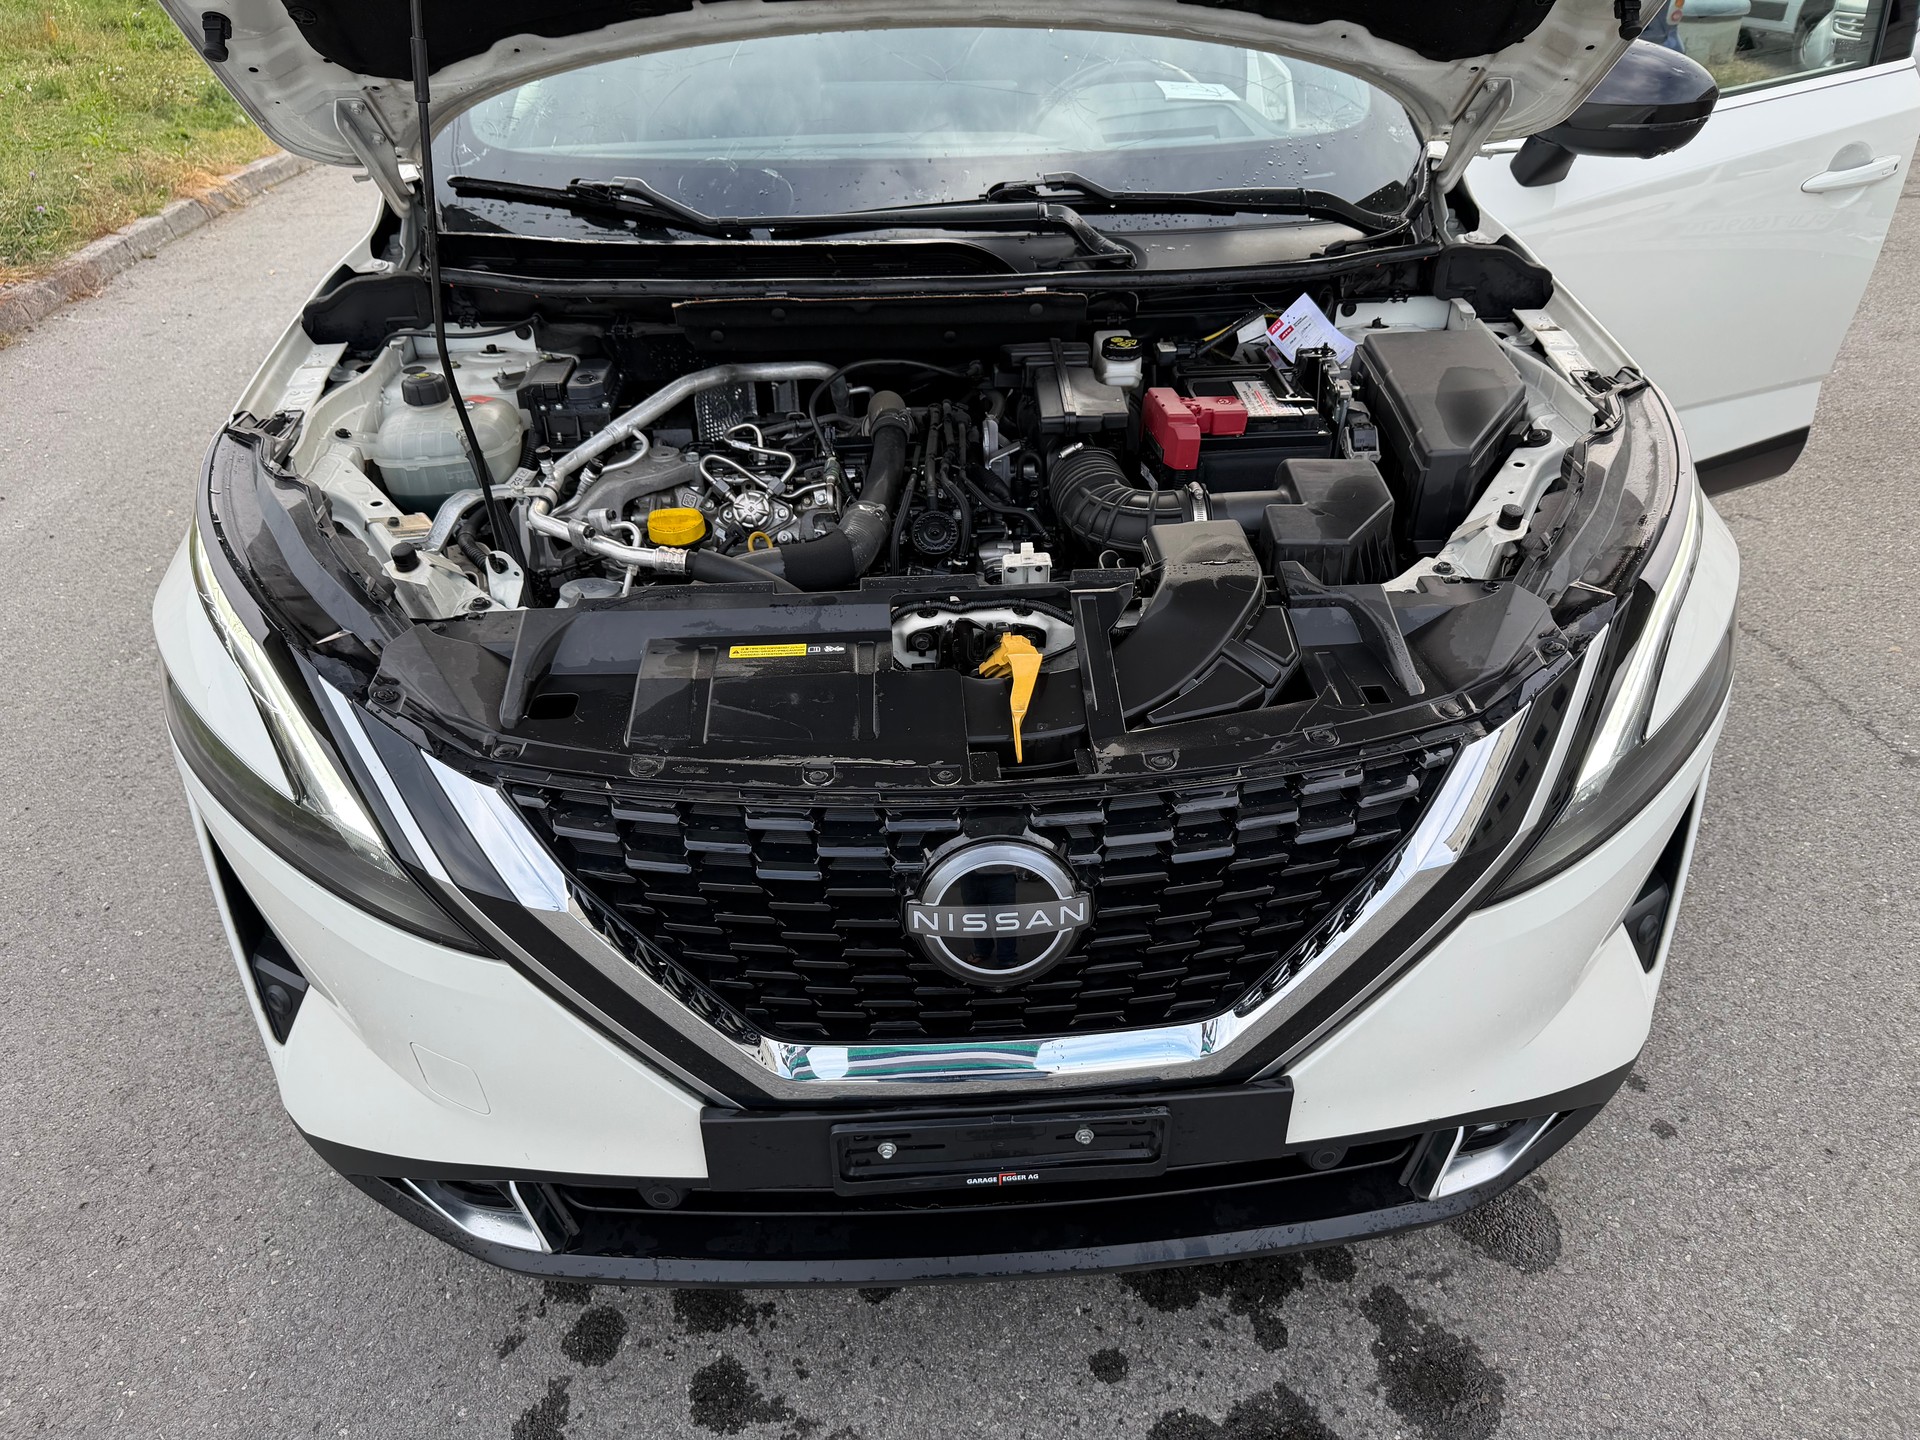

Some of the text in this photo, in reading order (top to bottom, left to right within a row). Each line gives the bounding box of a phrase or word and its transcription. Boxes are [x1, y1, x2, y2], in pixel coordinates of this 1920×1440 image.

[913, 902, 1084, 932] NISSAN
[966, 1176, 998, 1185] GARAGE
[1002, 1174, 1027, 1182] EGGER
